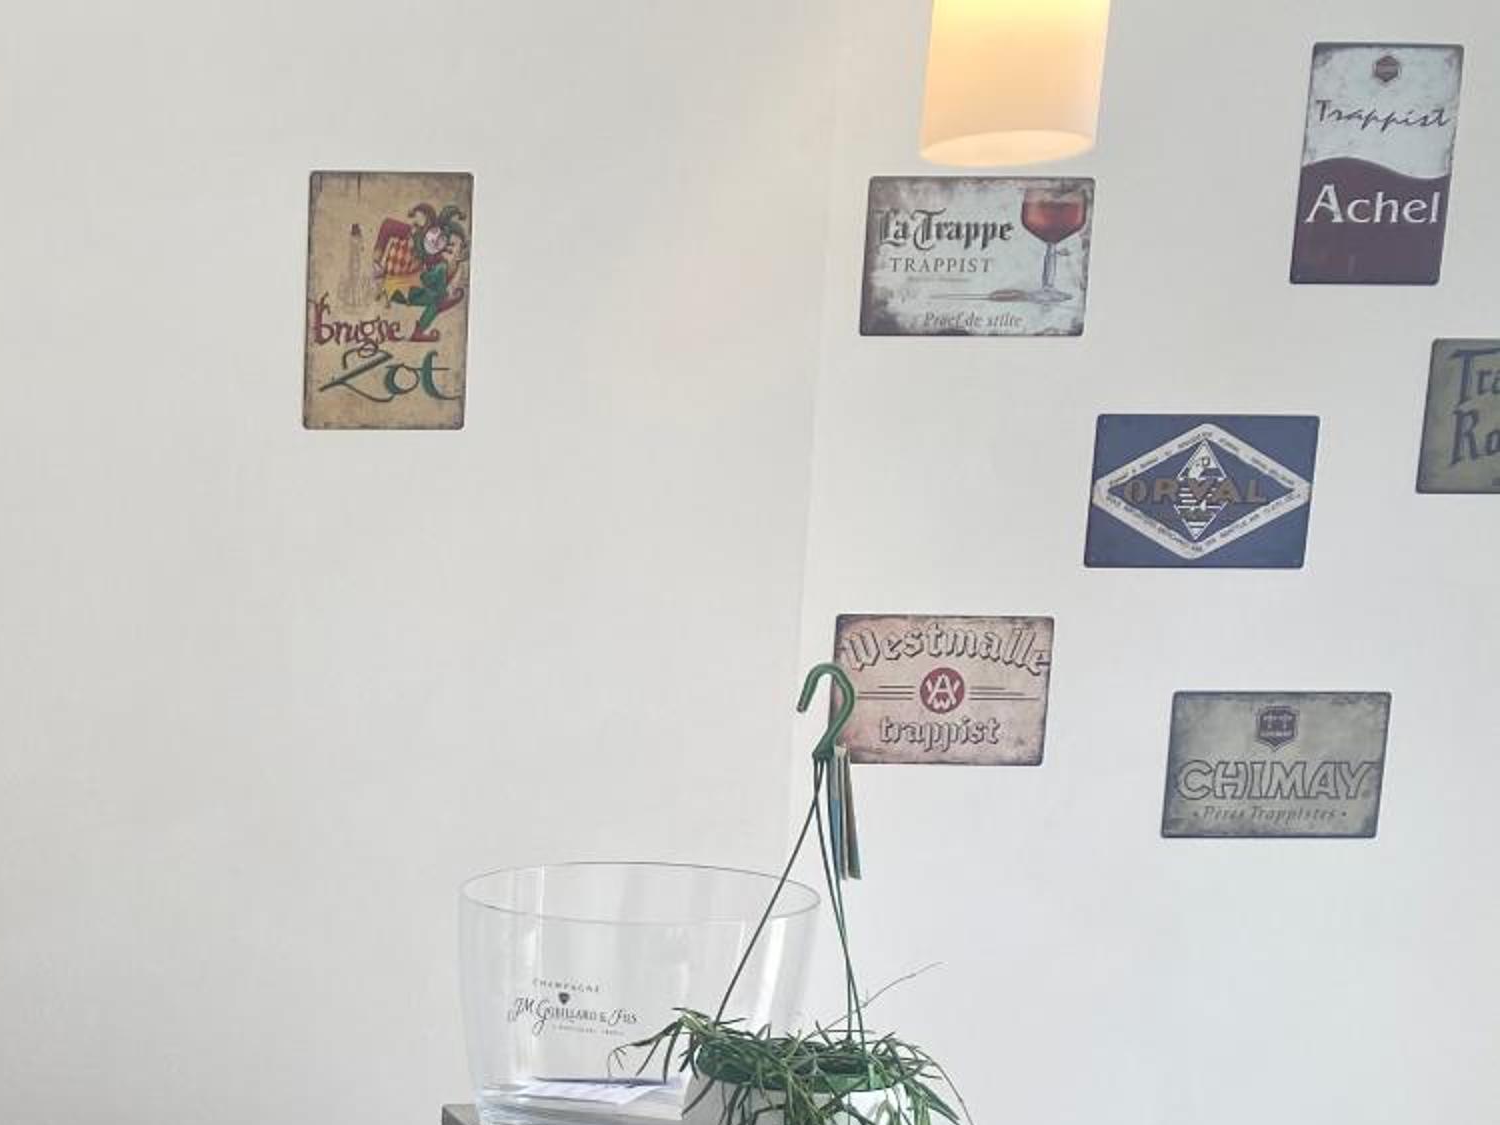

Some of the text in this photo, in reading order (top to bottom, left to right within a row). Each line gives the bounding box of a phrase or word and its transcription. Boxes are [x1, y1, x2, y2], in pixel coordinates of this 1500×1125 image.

[1315, 99, 1450, 132] Trappist
[1304, 183, 1441, 224] Achel
[911, 207, 1014, 250] Trappe
[891, 257, 994, 273] TRAPPIST
[312, 291, 405, 347] brugse
[319, 342, 462, 402] Zot
[1123, 478, 1267, 505] ORVAL
[841, 622, 1052, 677] Westmalle
[879, 715, 1001, 753] trappist
[1177, 759, 1383, 800] CHIMAY
